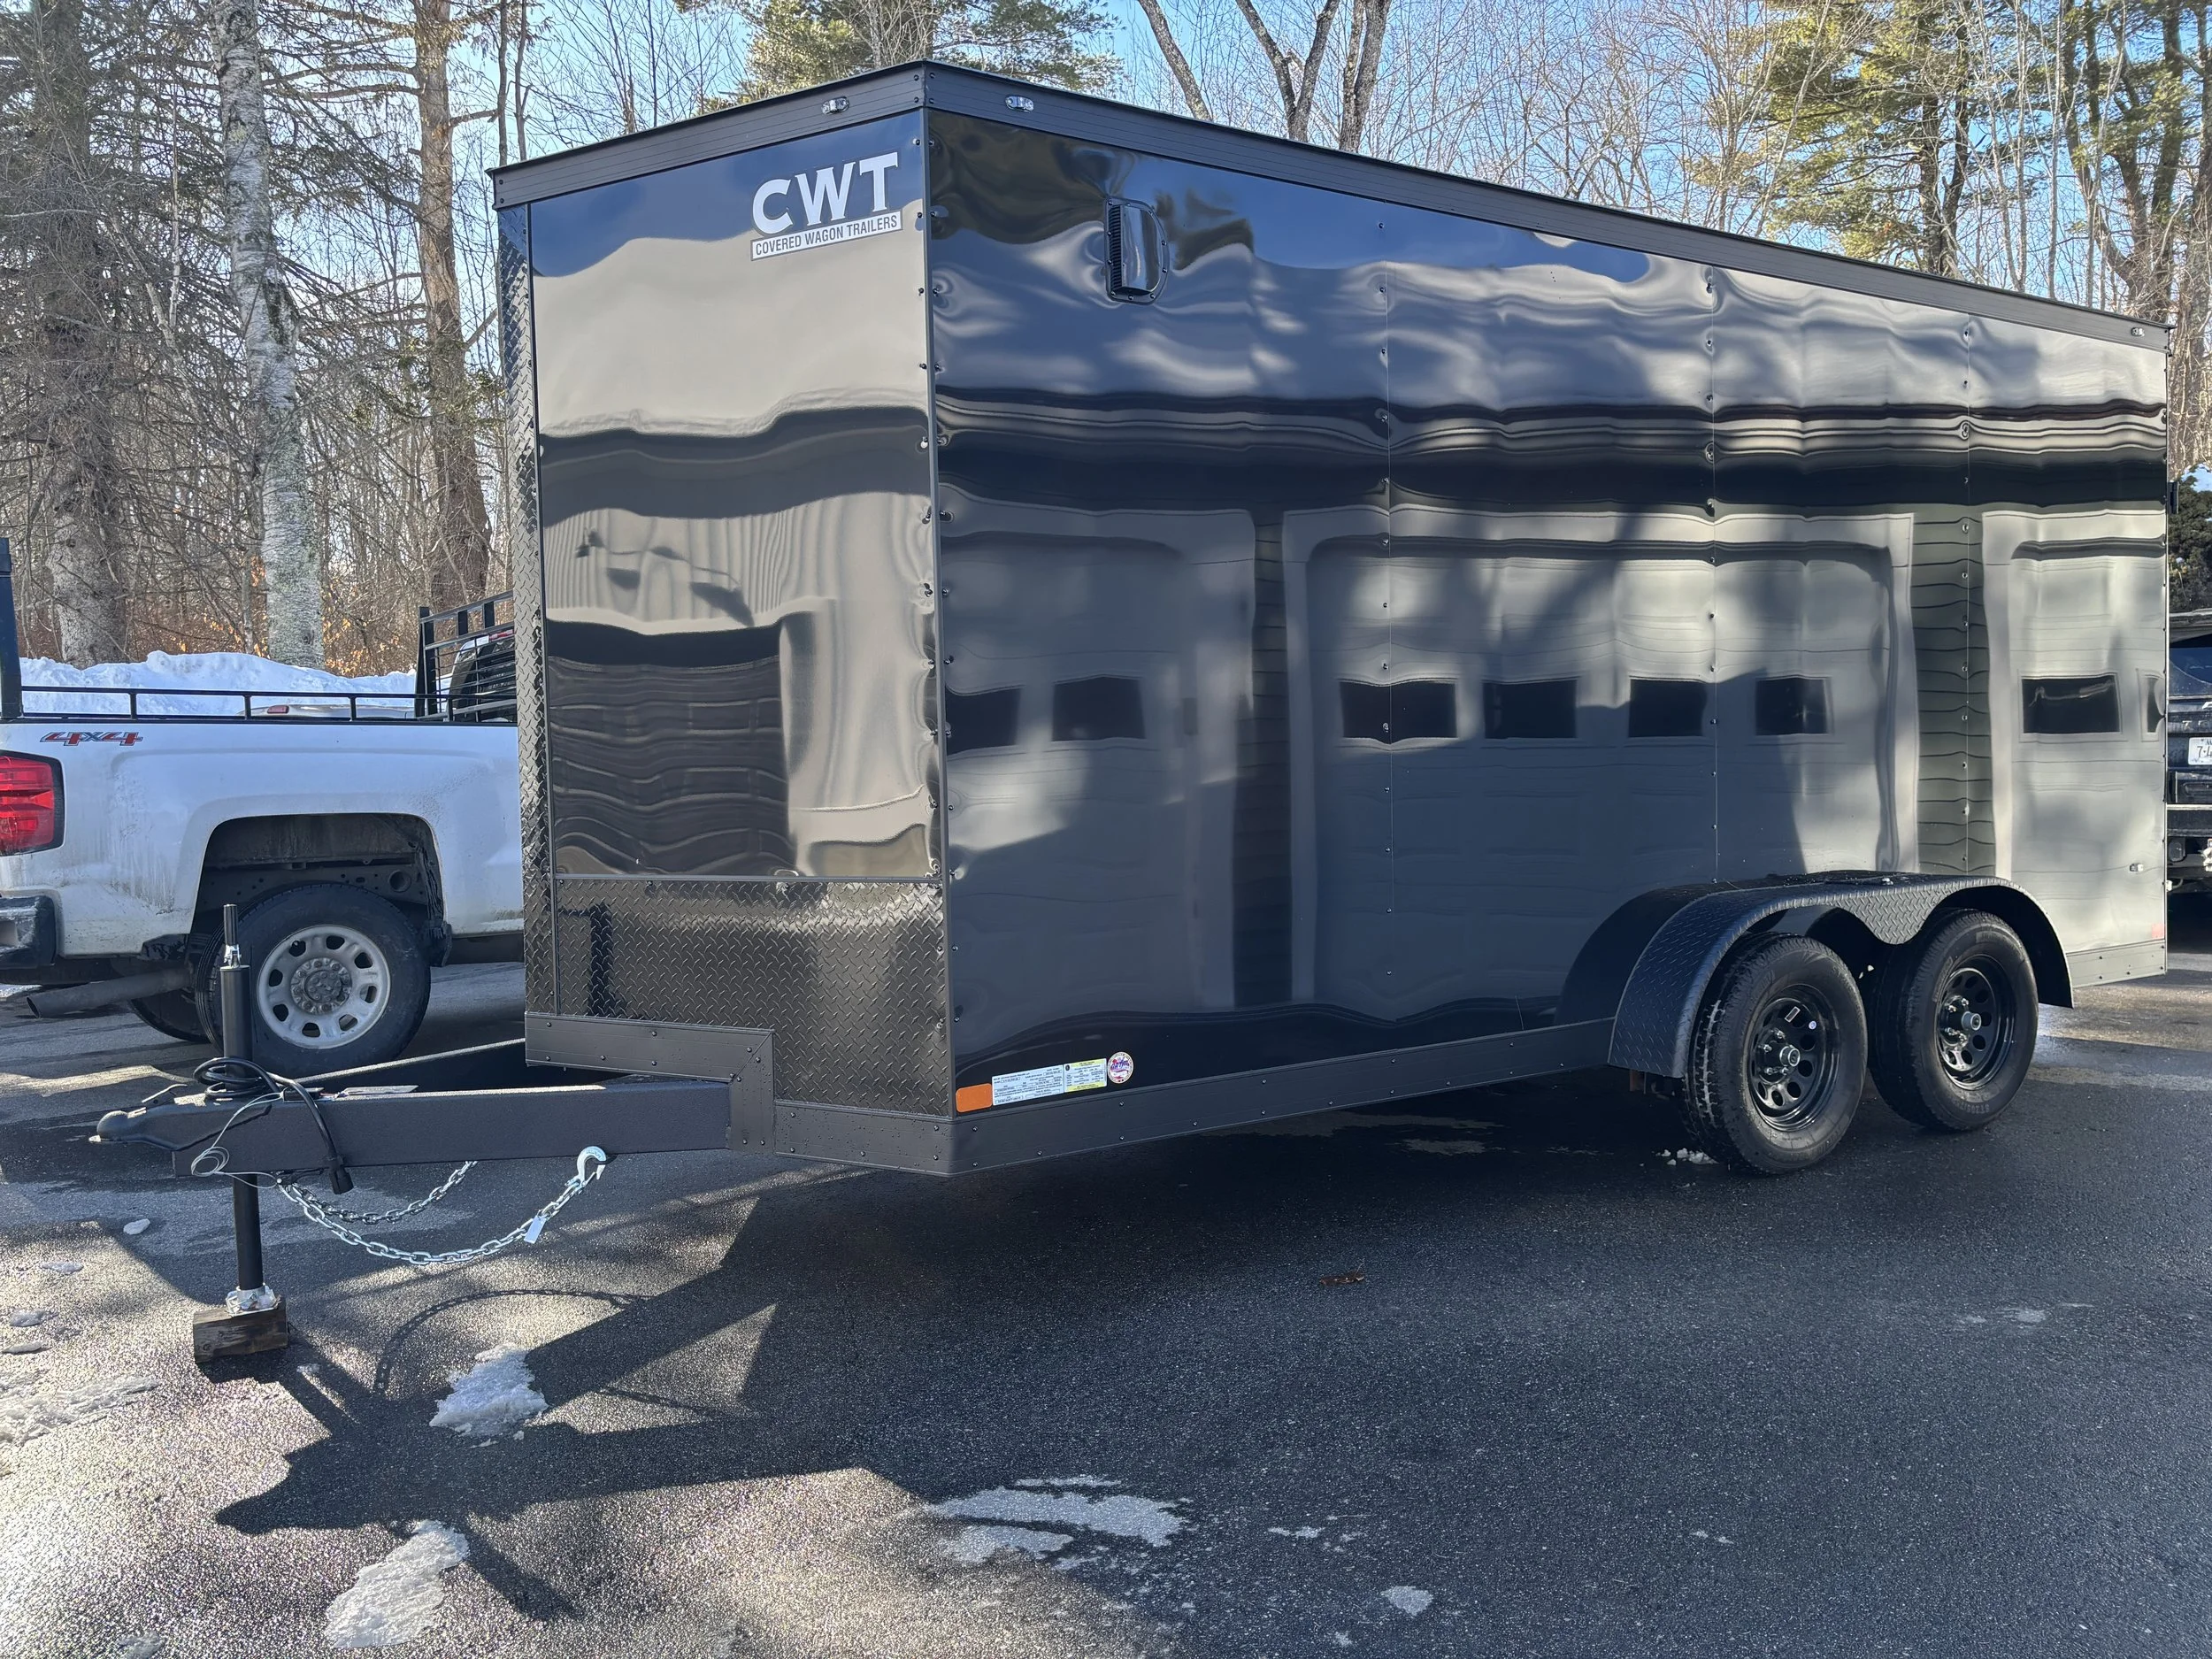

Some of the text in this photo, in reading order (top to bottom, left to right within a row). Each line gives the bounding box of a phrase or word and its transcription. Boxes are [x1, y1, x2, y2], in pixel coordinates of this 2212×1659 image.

[752, 151, 899, 234] CWT
[756, 215, 897, 256] COVERED WAGON TRAILERS
